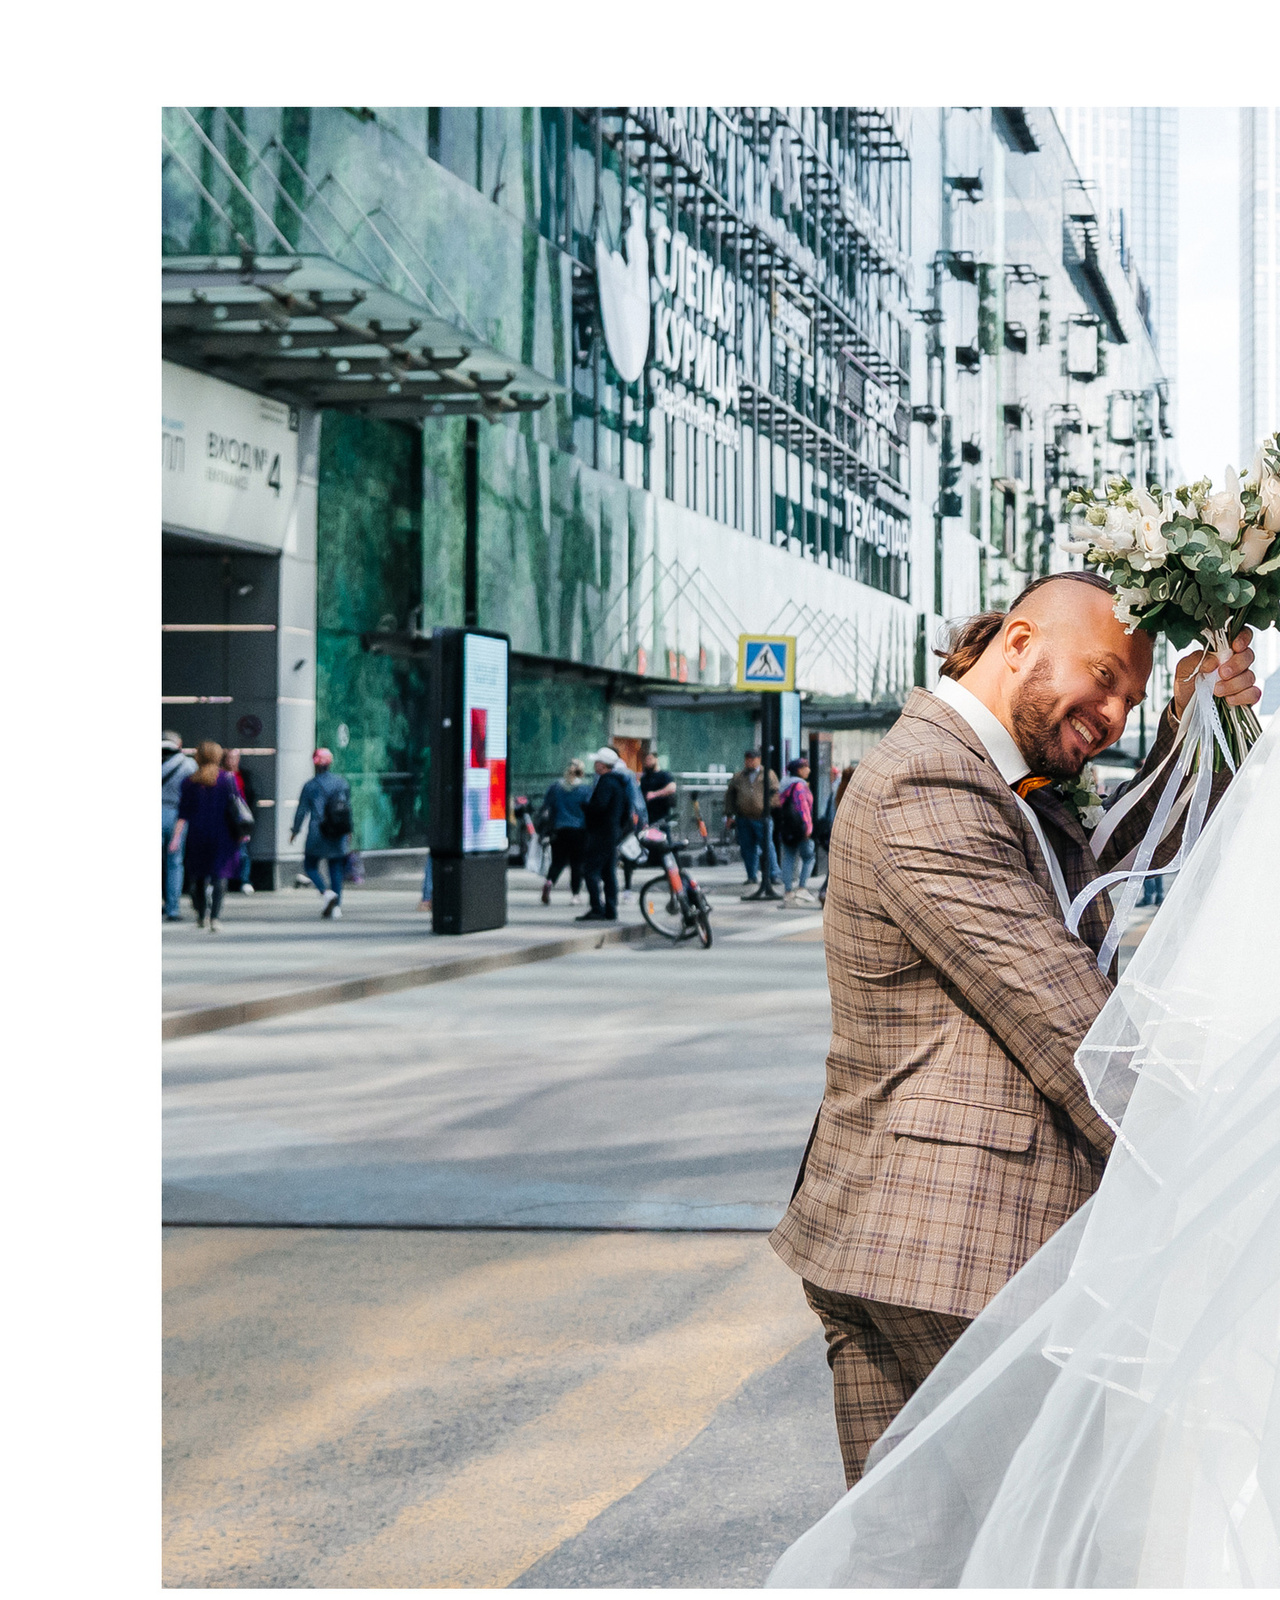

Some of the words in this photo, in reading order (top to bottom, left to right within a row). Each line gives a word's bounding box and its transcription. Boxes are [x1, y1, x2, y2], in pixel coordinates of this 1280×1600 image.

[654, 224, 736, 338] СЛЕПАЯ
[654, 300, 741, 413] КУРИЦА
[207, 431, 252, 473] ВХОД
[268, 453, 281, 498] 4
